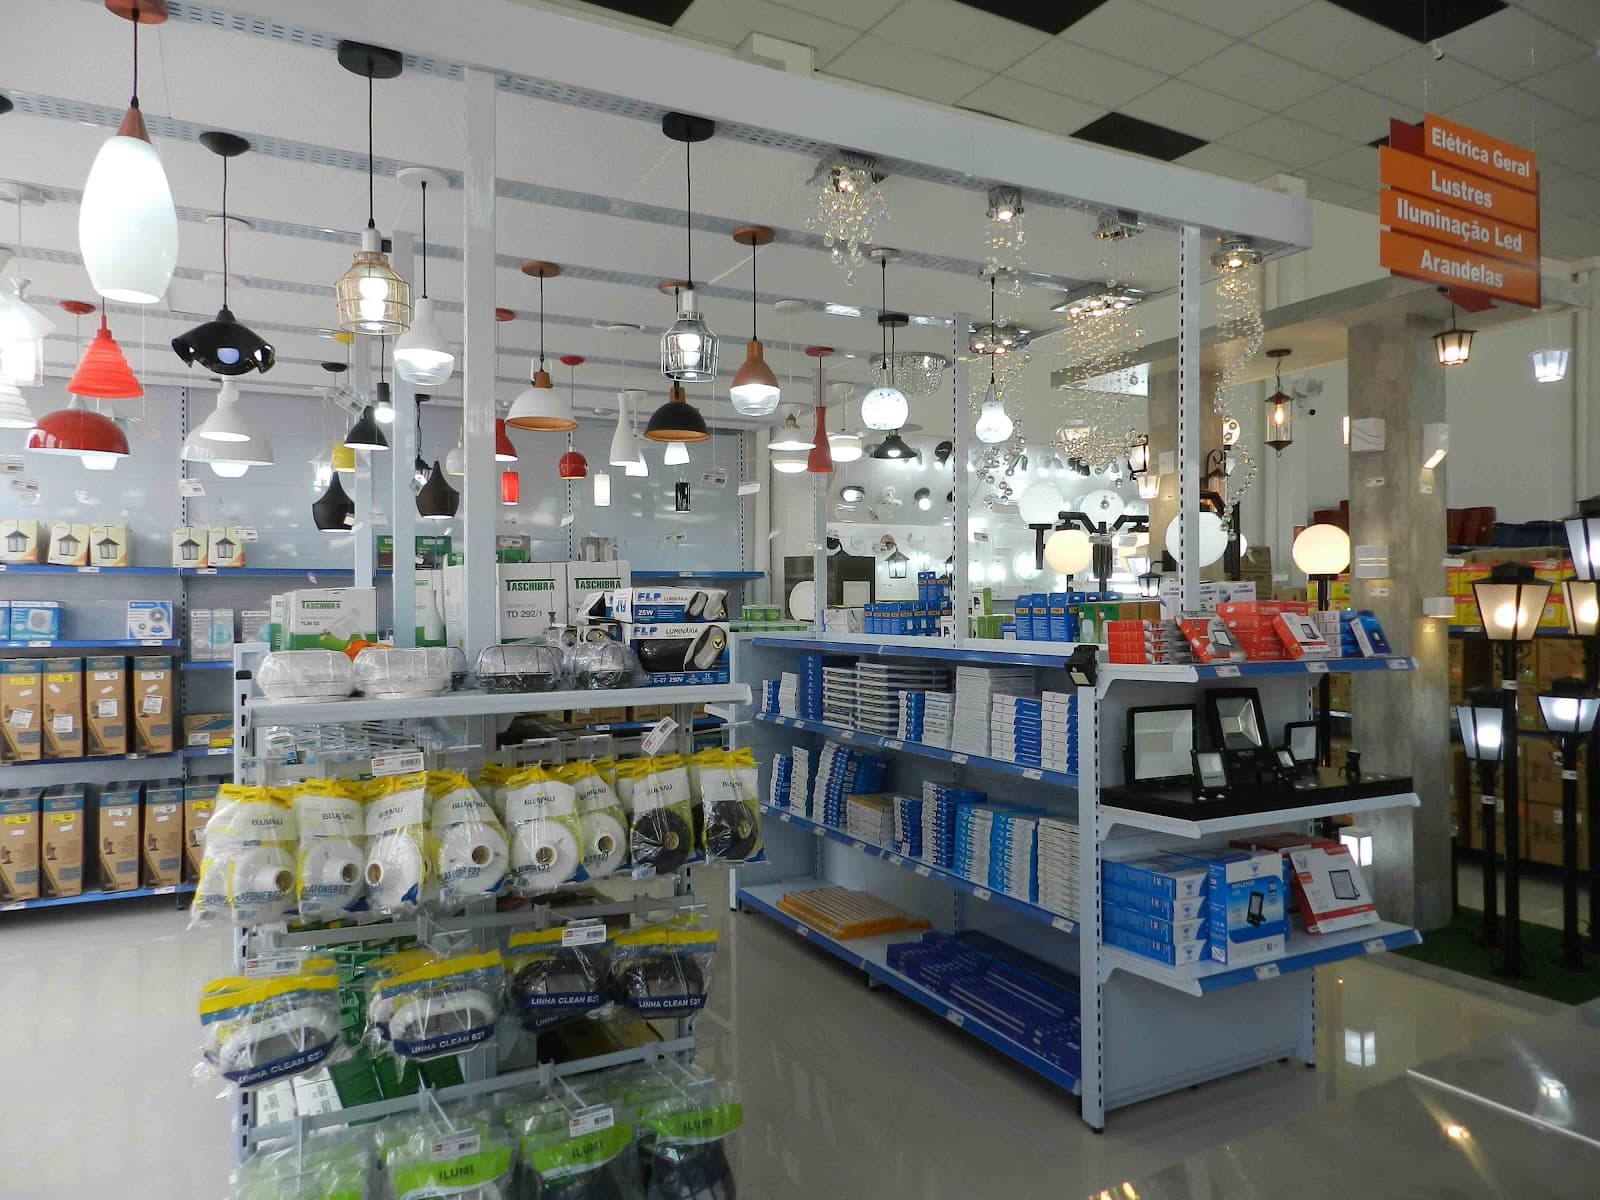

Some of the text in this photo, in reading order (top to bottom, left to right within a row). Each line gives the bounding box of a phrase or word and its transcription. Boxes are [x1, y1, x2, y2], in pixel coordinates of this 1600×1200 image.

[1431, 127, 1530, 178] Elétrica Geral
[1431, 170, 1493, 208] Lustres
[1397, 198, 1523, 253] Iluminação Led
[1420, 249, 1504, 288] Arandelas
[505, 579, 556, 591] TASCHIBRA
[574, 577, 622, 589] TASCHIBRA
[531, 996, 557, 1005] LINHA
[558, 995, 585, 1005] CLEAN
[663, 999, 689, 1008] CLEAN
[439, 1035, 470, 1048] CLEAN
[270, 1056, 305, 1073] CLEAN
[438, 1165, 475, 1181] ILUMI
